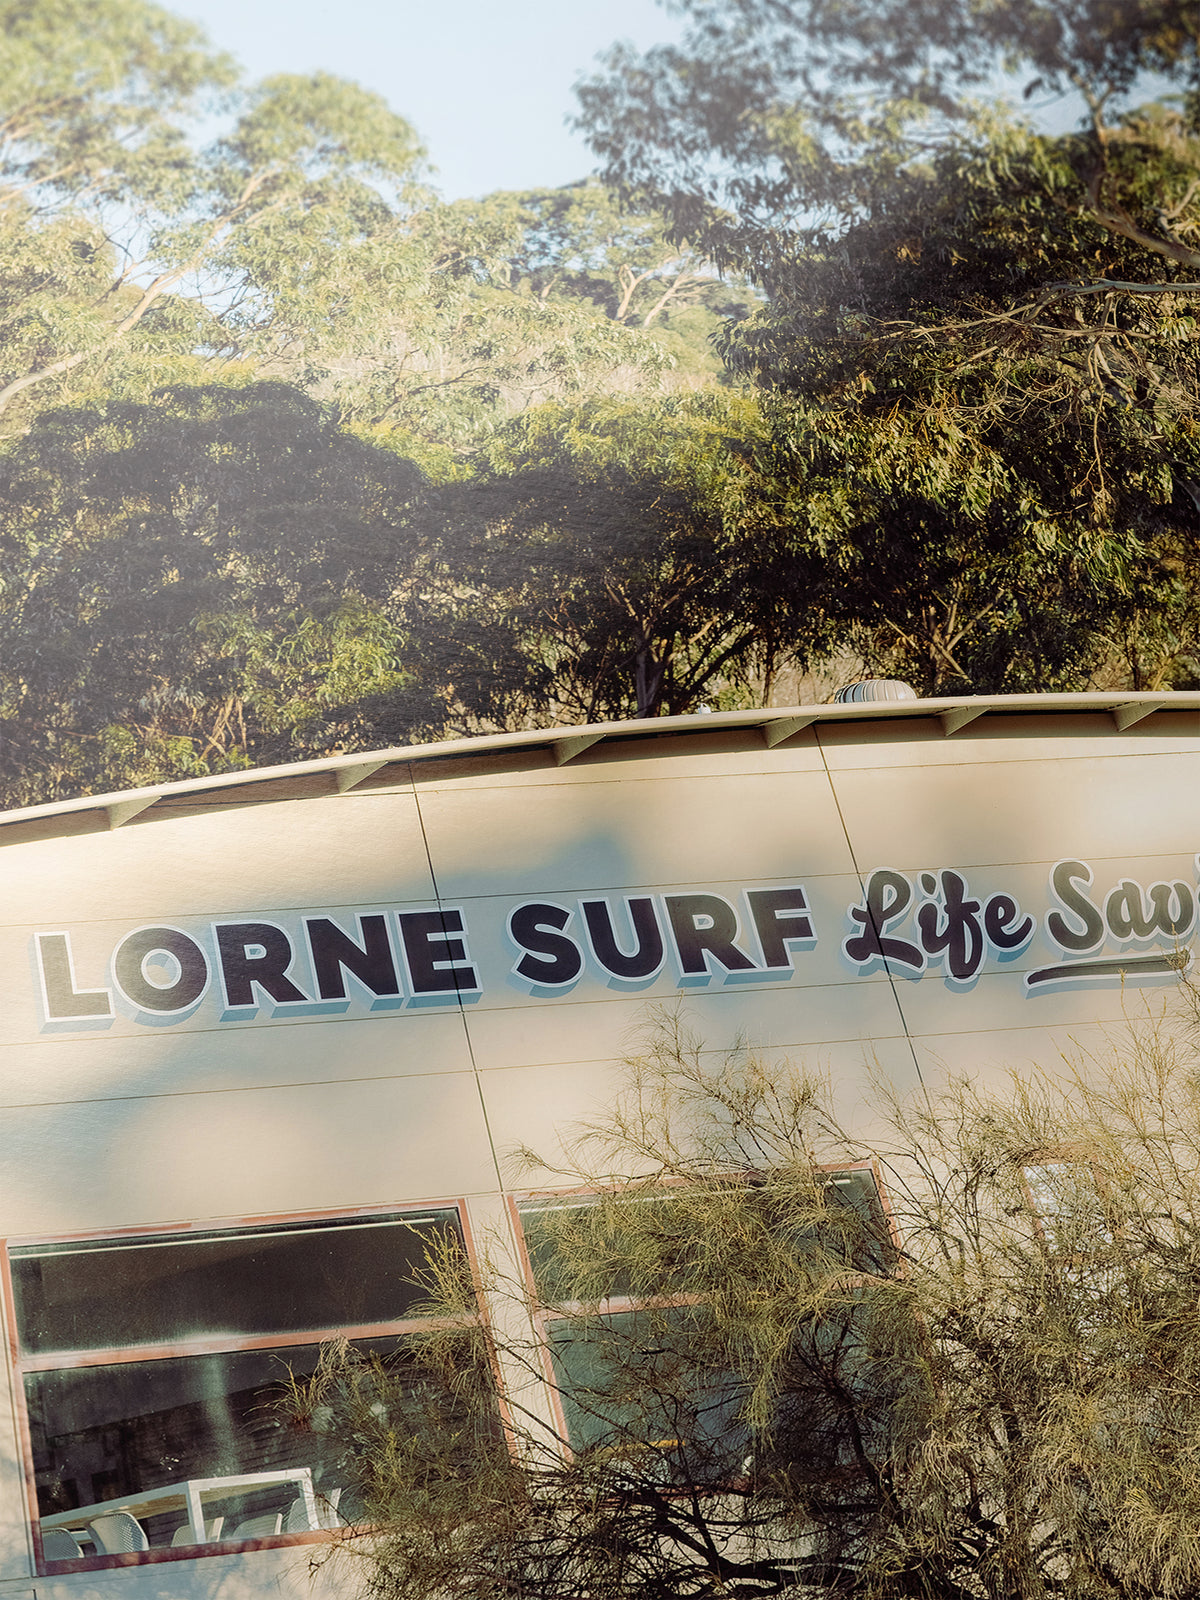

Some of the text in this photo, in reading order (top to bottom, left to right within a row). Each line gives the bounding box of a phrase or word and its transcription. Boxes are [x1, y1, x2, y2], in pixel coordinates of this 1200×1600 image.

[33, 856, 1200, 1024] LORNE SURF Life Sav
